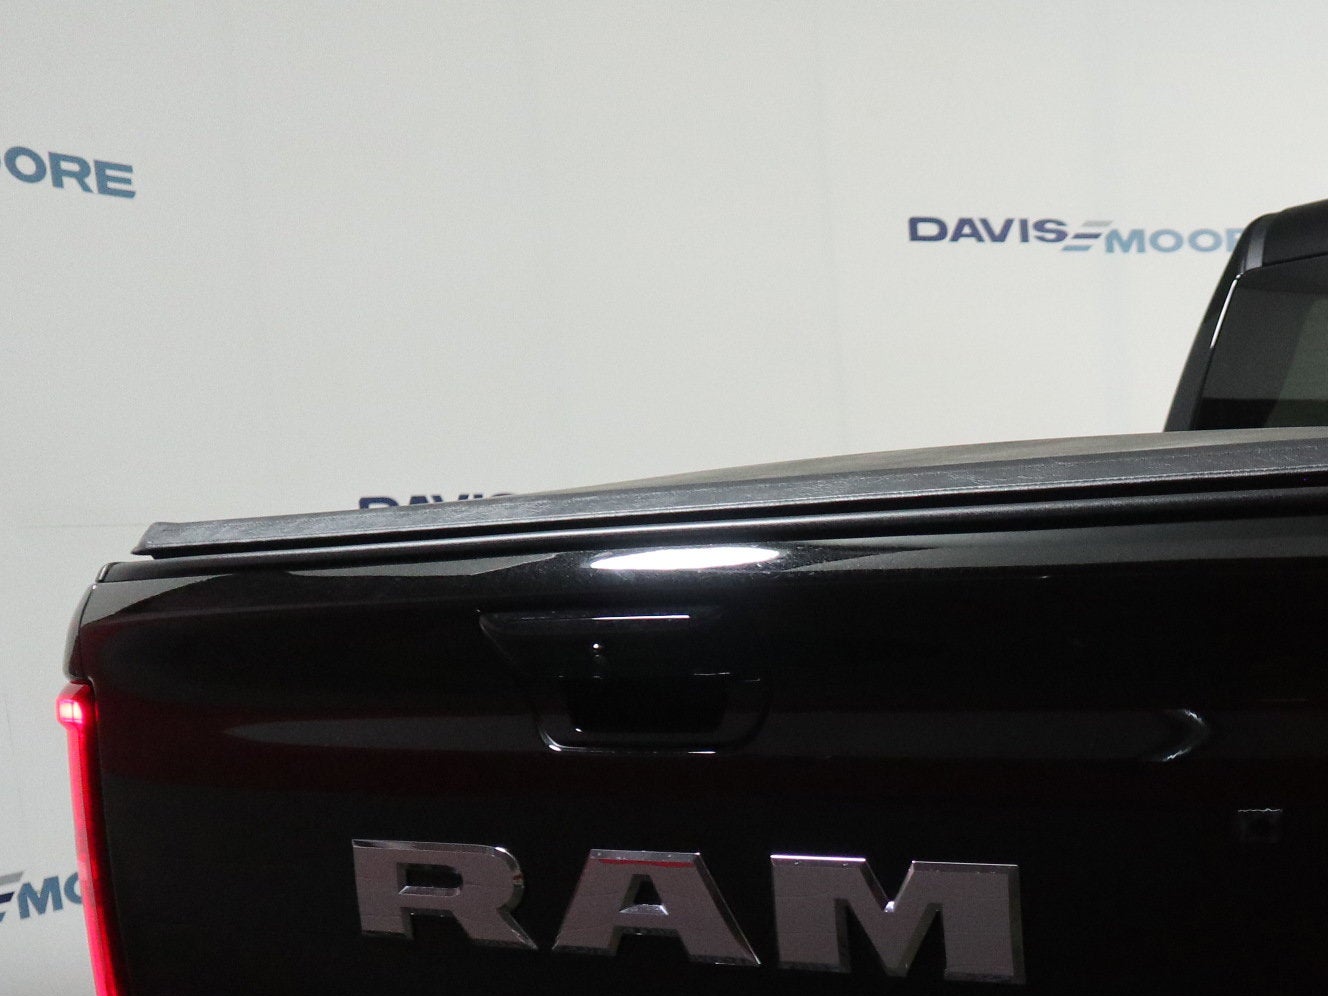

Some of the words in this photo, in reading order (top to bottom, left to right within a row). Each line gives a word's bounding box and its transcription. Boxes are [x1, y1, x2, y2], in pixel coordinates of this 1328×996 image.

[0, 145, 137, 199] ORE
[907, 216, 1069, 243] DAVIS
[351, 838, 1027, 986] RAM
